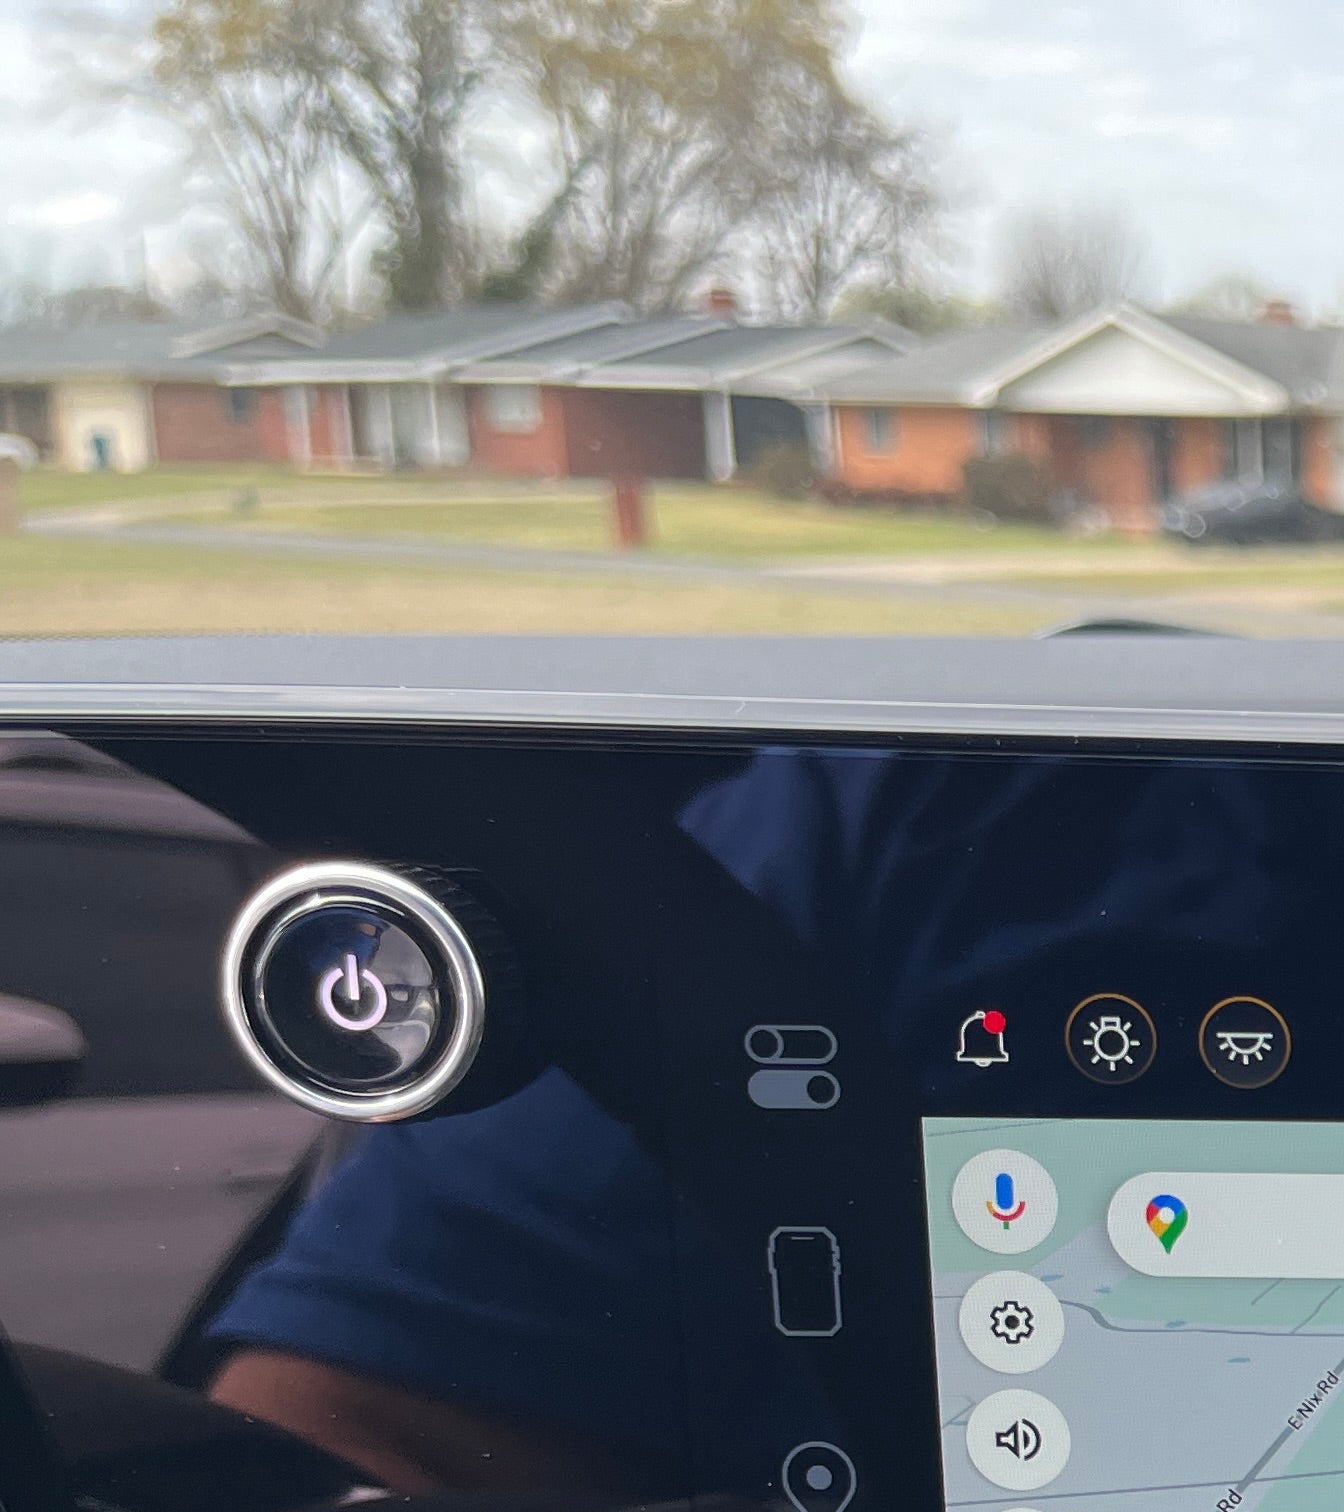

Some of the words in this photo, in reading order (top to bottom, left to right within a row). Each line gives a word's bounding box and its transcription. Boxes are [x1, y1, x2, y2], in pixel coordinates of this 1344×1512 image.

[1287, 1414, 1304, 1432] E
[1297, 1389, 1325, 1418] Nix
[1317, 1371, 1340, 1394] Rd
